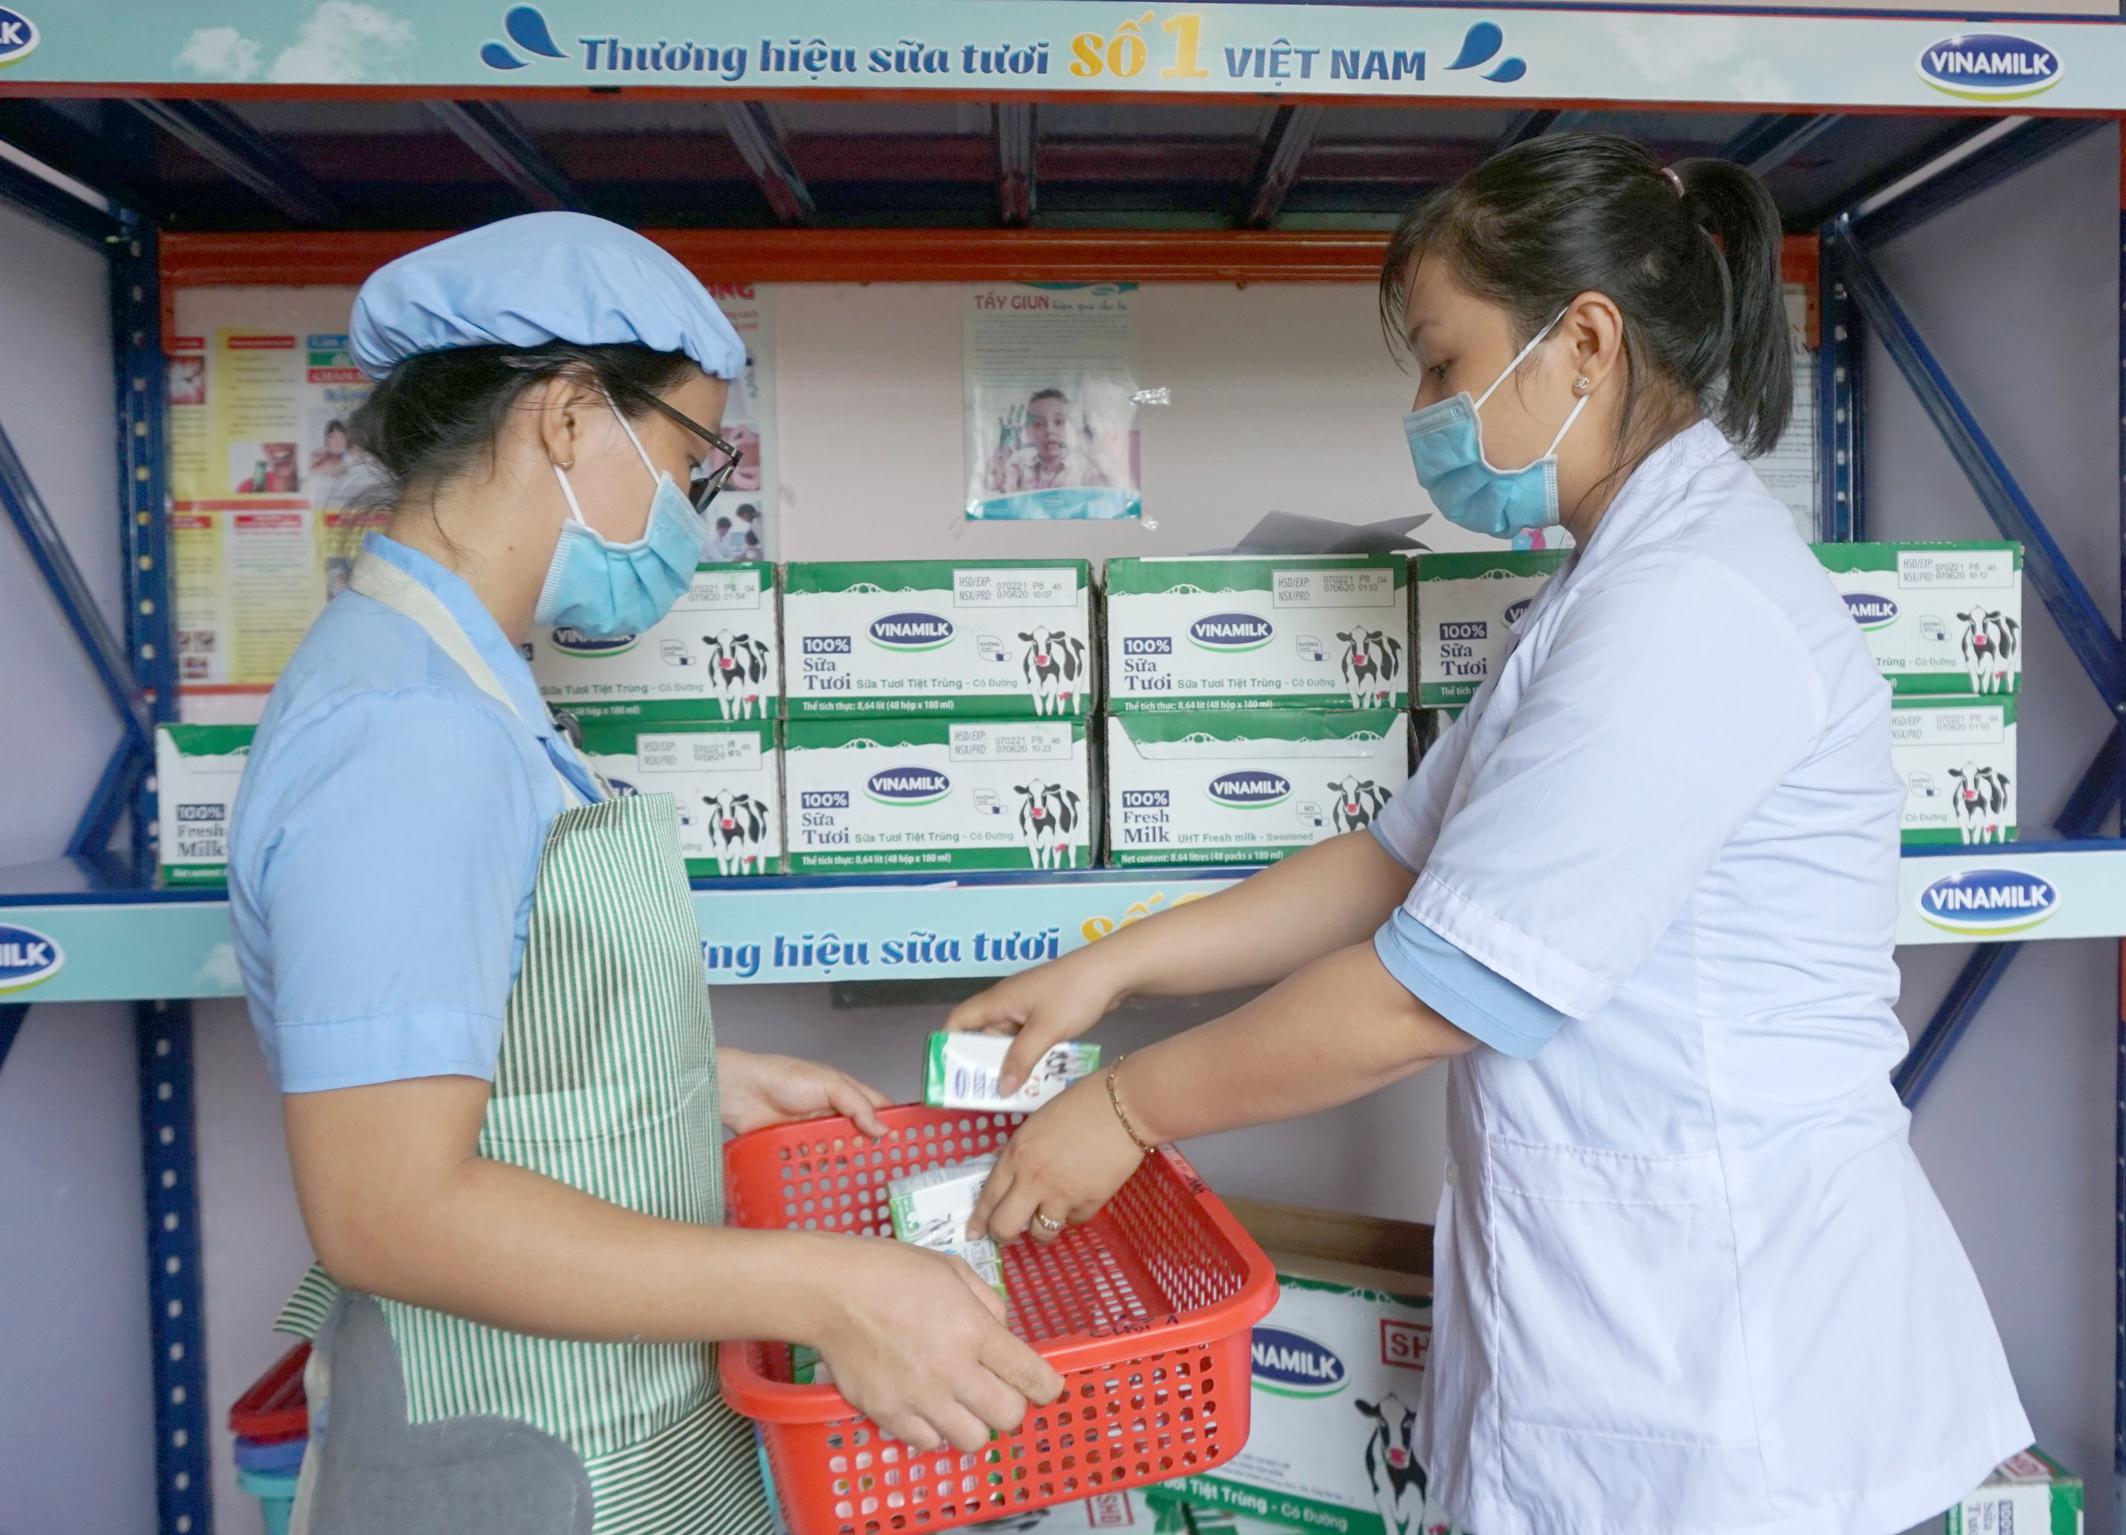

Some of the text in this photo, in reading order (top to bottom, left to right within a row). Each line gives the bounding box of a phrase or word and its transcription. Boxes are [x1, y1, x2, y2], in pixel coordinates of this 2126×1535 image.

[579, 36, 747, 82] Thương
[759, 37, 857, 81] hiệu
[867, 39, 951, 74] sữa
[961, 39, 1050, 75] tươi
[1161, 13, 1209, 79] 1
[1224, 37, 1320, 87] VIỆT
[1330, 49, 1426, 82] NAM
[1930, 51, 2051, 75] VINAMILK
[1011, 295, 1049, 310] GIUN
[874, 622, 949, 637] VINAMILK
[1194, 622, 1269, 638] VINAMILK
[1442, 624, 1485, 638] 100%
[804, 638, 849, 652] 100%
[1125, 639, 1170, 653] 100%
[1440, 642, 1472, 658] Sữa
[803, 657, 836, 672] Sữa
[1124, 658, 1157, 673] Sữa
[1440, 658, 1487, 676] Tươi
[803, 673, 851, 690] Tươi
[856, 679, 877, 689] Sữa
[880, 679, 904, 689] Tươi
[906, 678, 928, 690] Tiệt
[930, 678, 963, 690] Trùng
[1124, 673, 1172, 691] Tươi
[1177, 678, 1198, 689] Sữa
[1201, 678, 1224, 688] Tươi
[1227, 678, 1248, 689] Tiệt
[1250, 678, 1282, 689] Trùng
[872, 776, 945, 791] VINAMILK
[1213, 780, 1286, 795] VINAMILK
[802, 794, 847, 807] 100%
[1124, 792, 1168, 806] 100%
[180, 806, 222, 819] 100%
[801, 812, 834, 827] Sữa
[1123, 810, 1170, 824] Fresh
[801, 827, 849, 845] Tươi
[855, 833, 875, 843] Sữa
[878, 833, 902, 843] Tươi
[904, 832, 925, 843] Tiệt
[927, 832, 960, 843] Trùng
[1124, 826, 1170, 843] Milk
[1177, 831, 1314, 843] UHT Fresh milk Sweetened
[178, 840, 225, 857] Milk
[1121, 854, 1136, 864] Net
[1136, 854, 1169, 864] content:
[1188, 852, 1209, 862] litres
[1224, 852, 1247, 863] packs
[1929, 884, 2048, 910] VINAMILK
[773, 933, 869, 974] hiệu
[881, 930, 959, 965] sữa
[973, 928, 1060, 962] tươi
[1190, 1479, 1218, 1500] Tiệt
[1221, 1487, 1268, 1515] Trùng
[1281, 1503, 1300, 1519] Có
[1303, 1508, 1348, 1533] Đường
